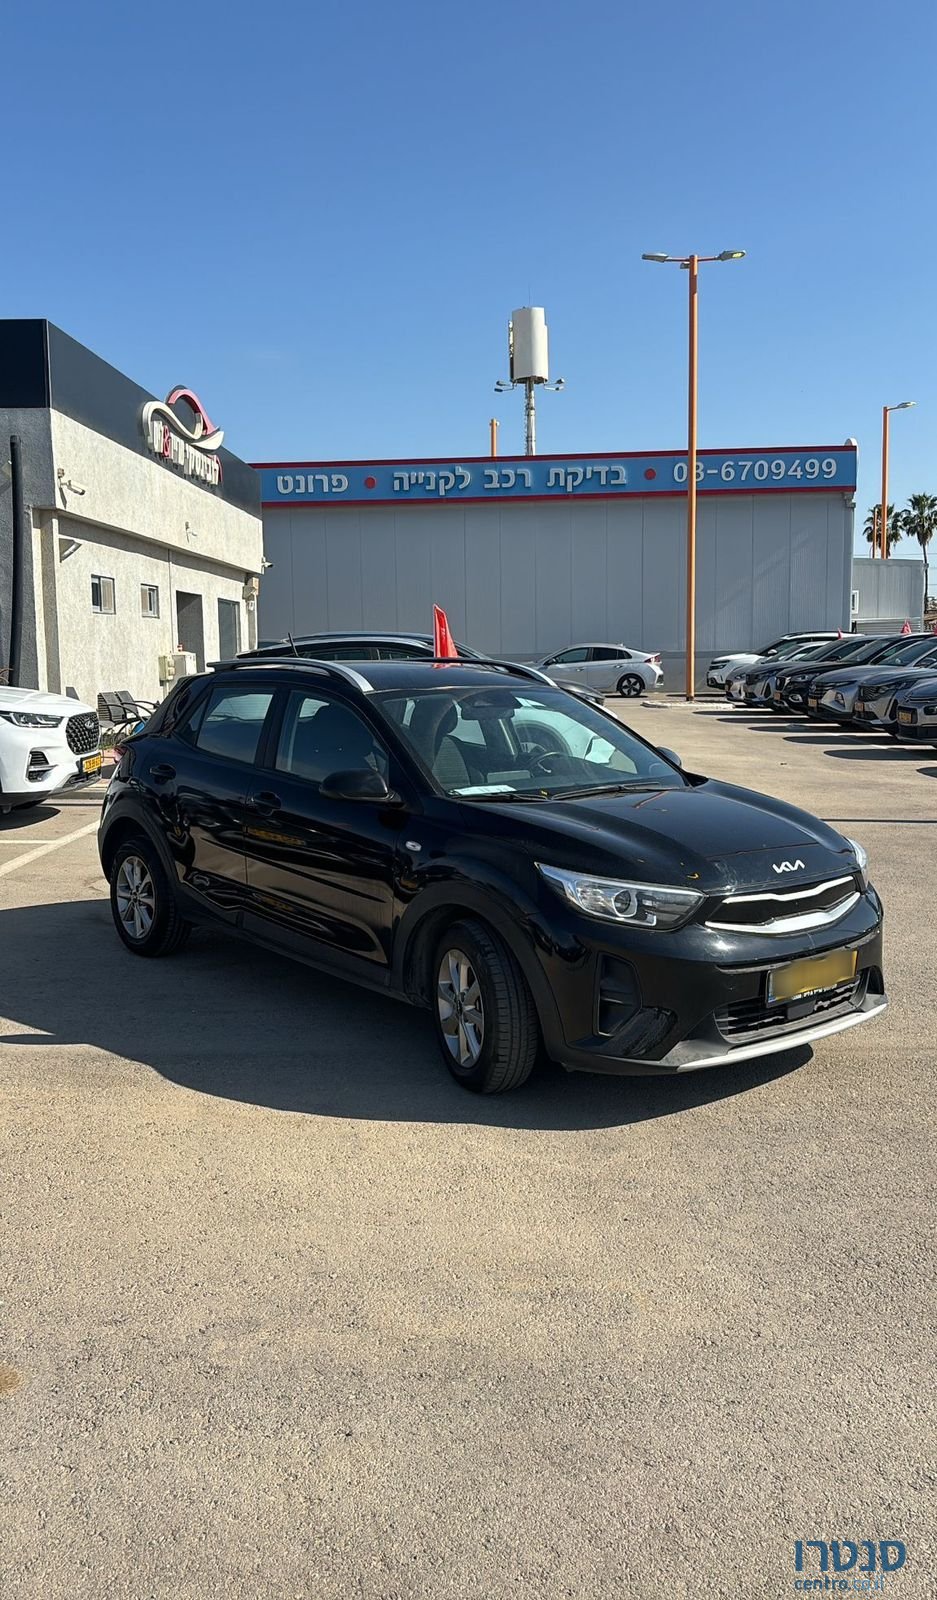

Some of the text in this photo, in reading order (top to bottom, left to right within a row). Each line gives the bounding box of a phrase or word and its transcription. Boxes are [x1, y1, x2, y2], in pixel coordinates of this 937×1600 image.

[276, 458, 837, 496] 03-6709499 בדיקת רכב לקנייה פרונט
